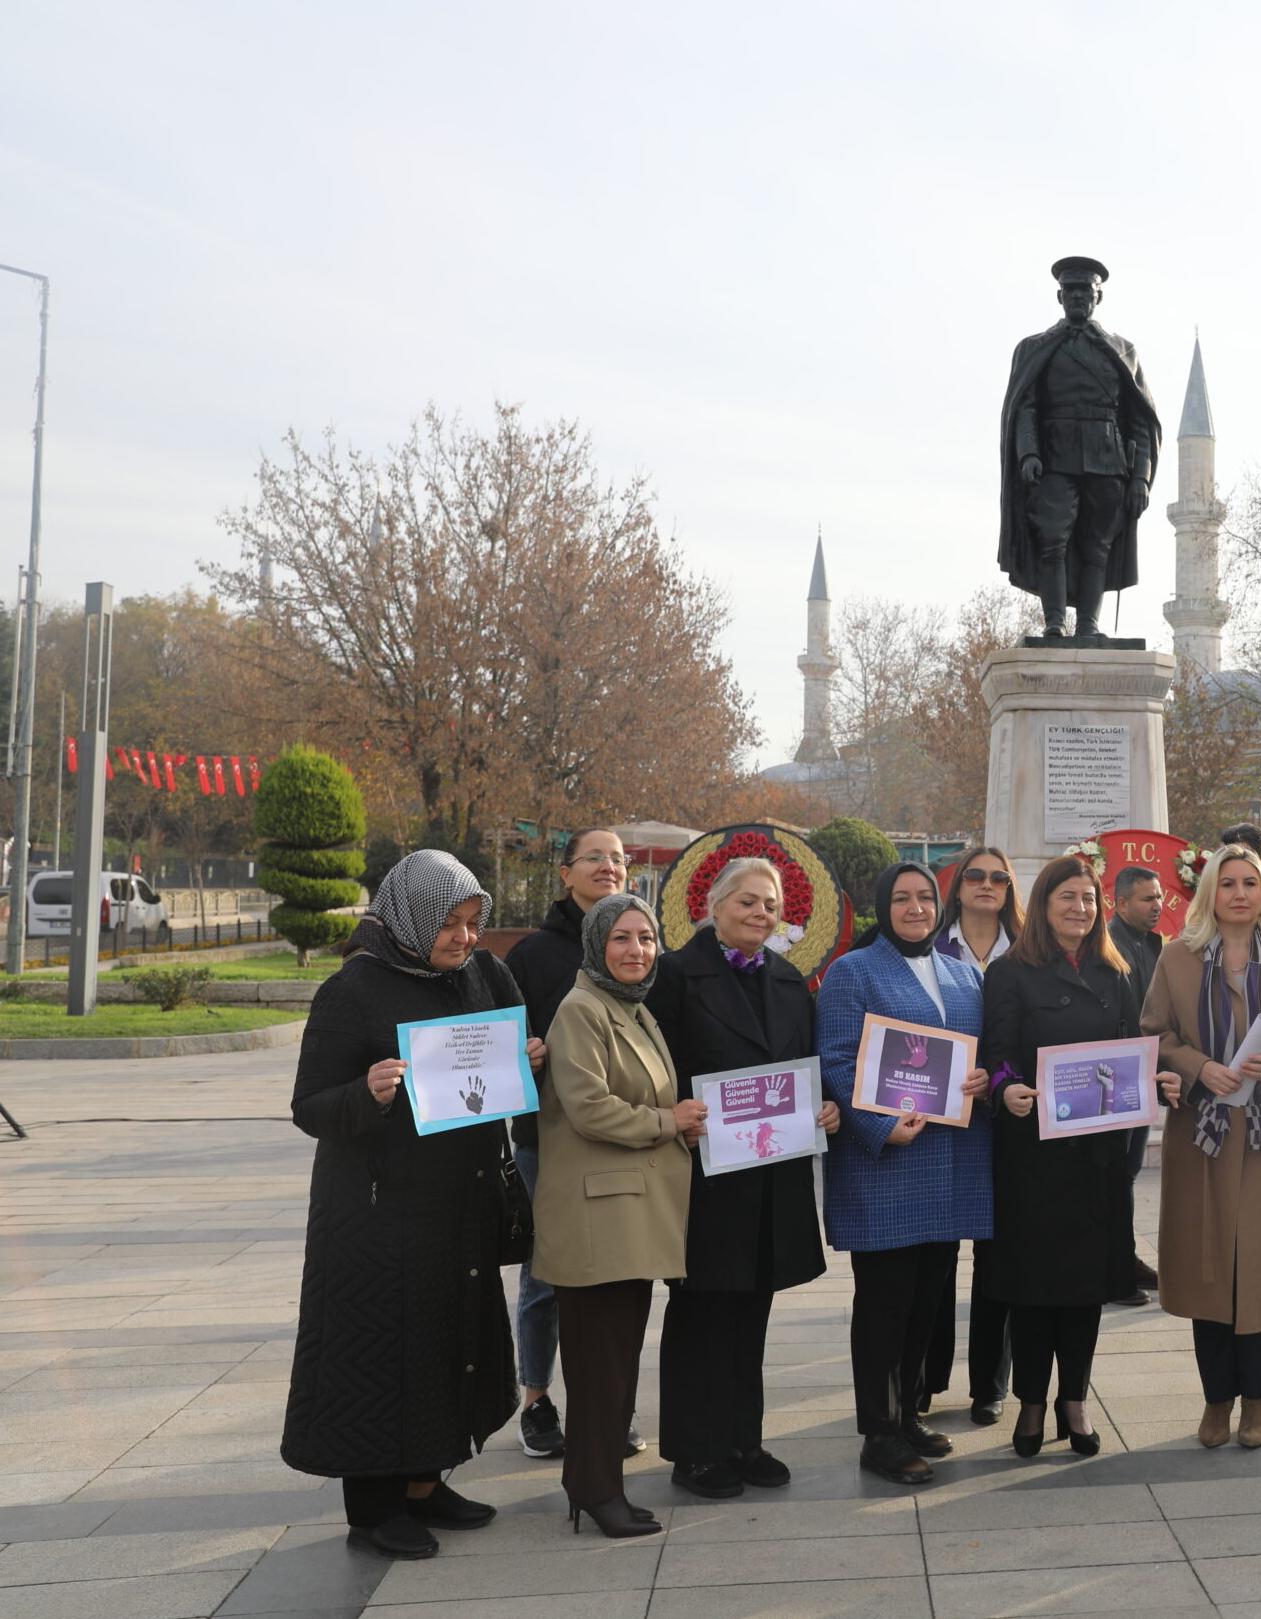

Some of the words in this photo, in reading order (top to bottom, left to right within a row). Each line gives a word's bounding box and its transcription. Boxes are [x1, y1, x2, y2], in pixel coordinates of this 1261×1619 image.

[1061, 726, 1083, 734] TÜRK
[1122, 842, 1160, 863] T.C.
[894, 1070, 904, 1079] 25
[905, 1072, 931, 1083] KASIM
[725, 1077, 757, 1089] Güvenle
[725, 1087, 760, 1098] Güvende
[726, 1095, 755, 1107] Güvenli
